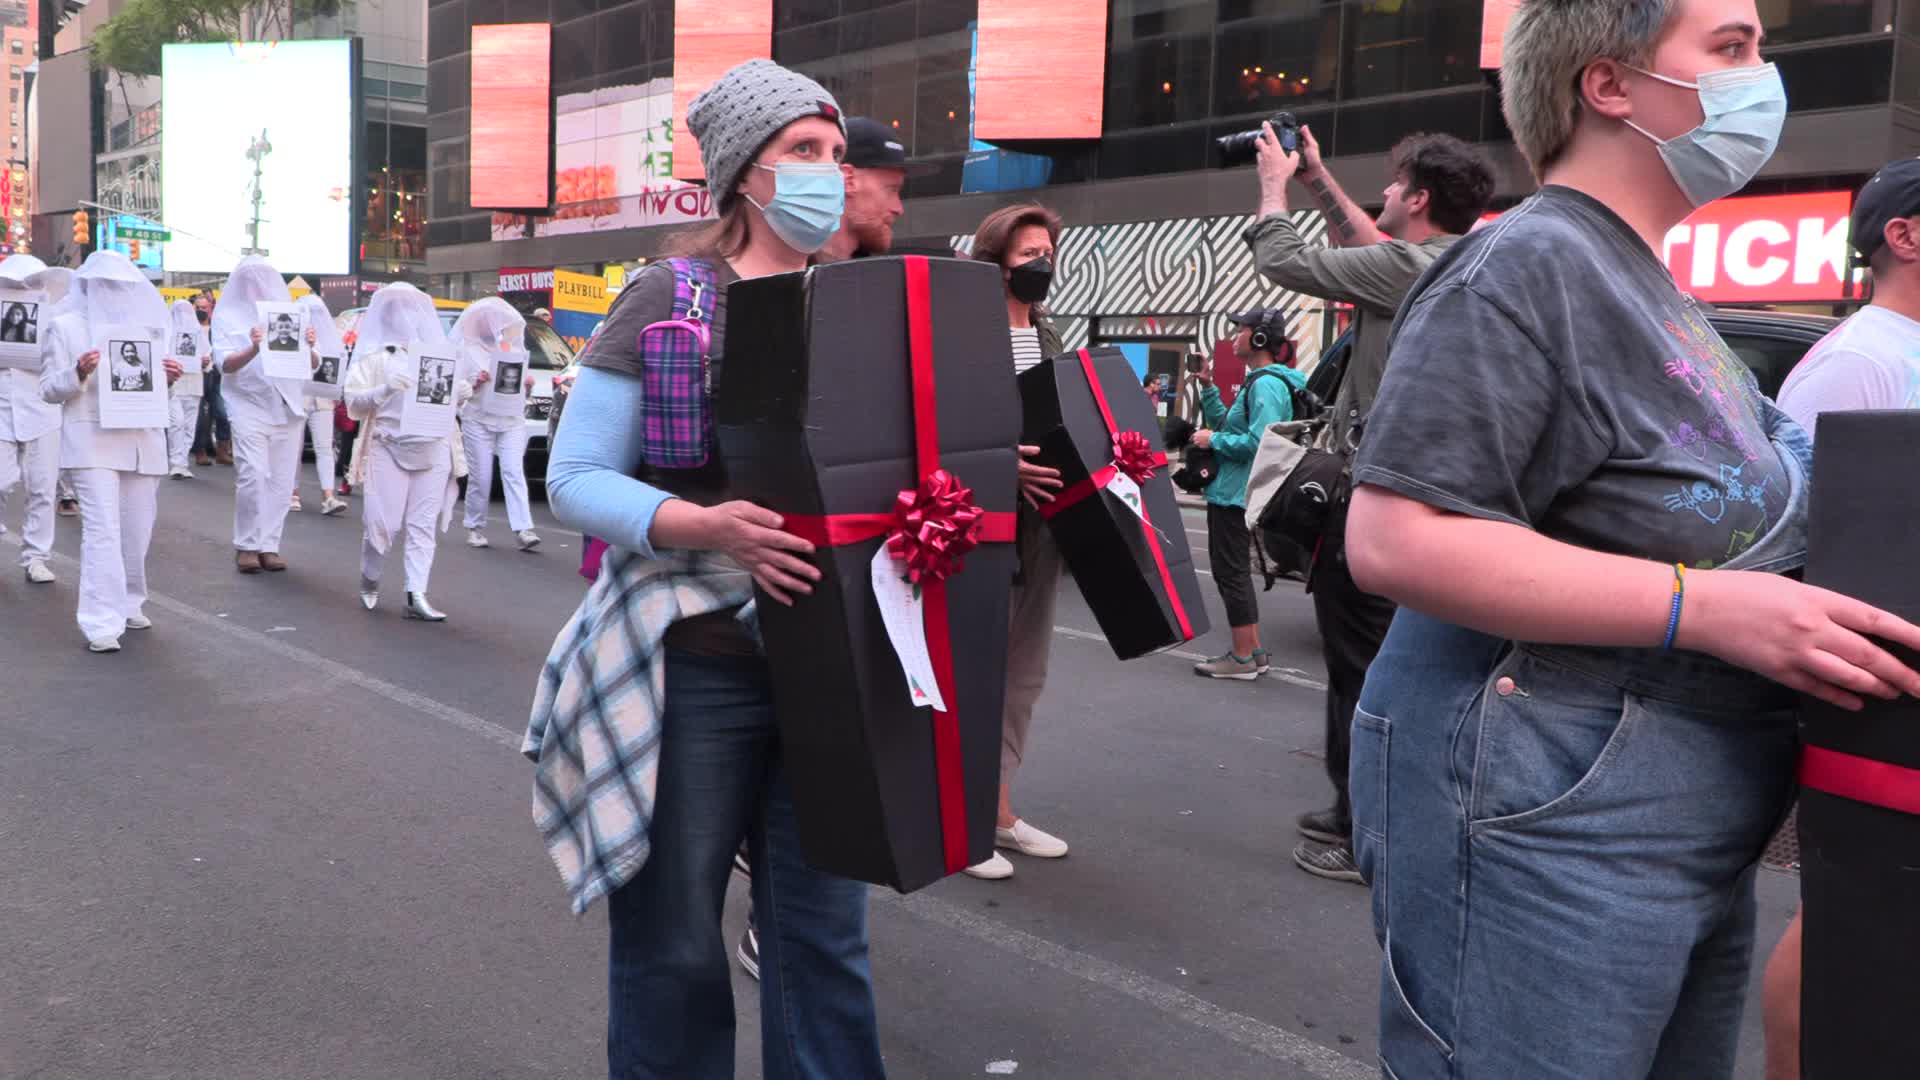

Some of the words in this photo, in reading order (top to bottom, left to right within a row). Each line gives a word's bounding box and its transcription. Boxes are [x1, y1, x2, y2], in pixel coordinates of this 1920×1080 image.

[498, 274, 530, 291] JERSEY
[532, 271, 554, 288] BOYS
[558, 280, 604, 299] PLAYBILL
